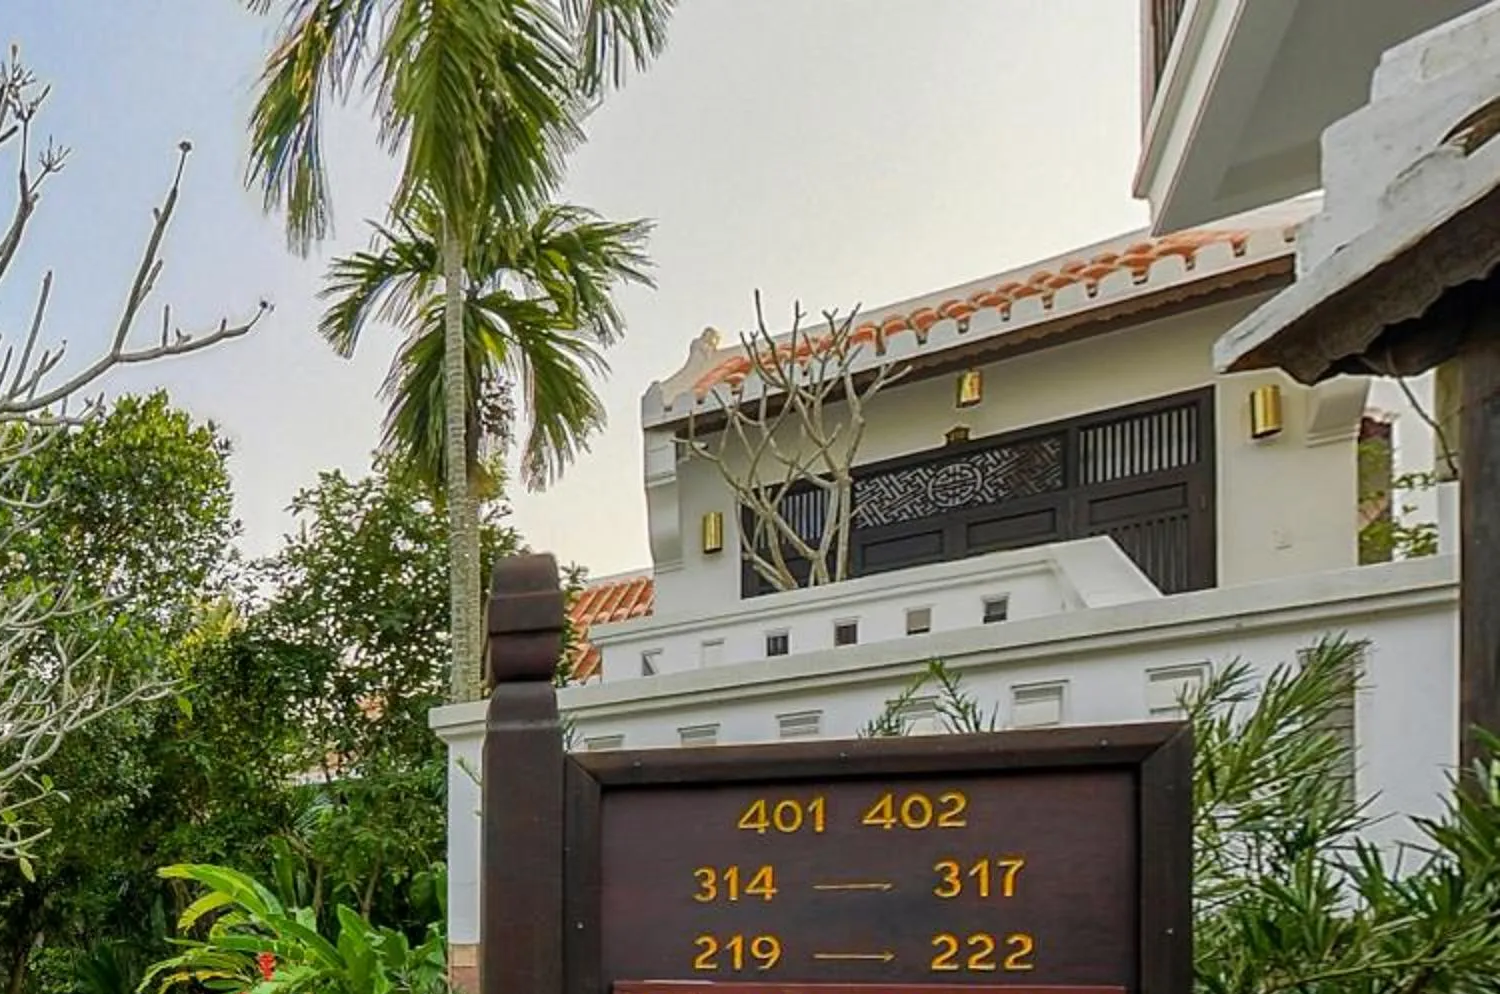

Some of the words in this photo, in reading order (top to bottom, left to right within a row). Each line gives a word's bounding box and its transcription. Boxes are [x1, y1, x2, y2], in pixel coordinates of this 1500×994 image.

[737, 795, 828, 834] 401
[861, 790, 968, 830] 402
[692, 863, 780, 902] 314
[932, 857, 1025, 898] 317
[693, 933, 782, 970] 219
[930, 931, 1034, 971] 222
